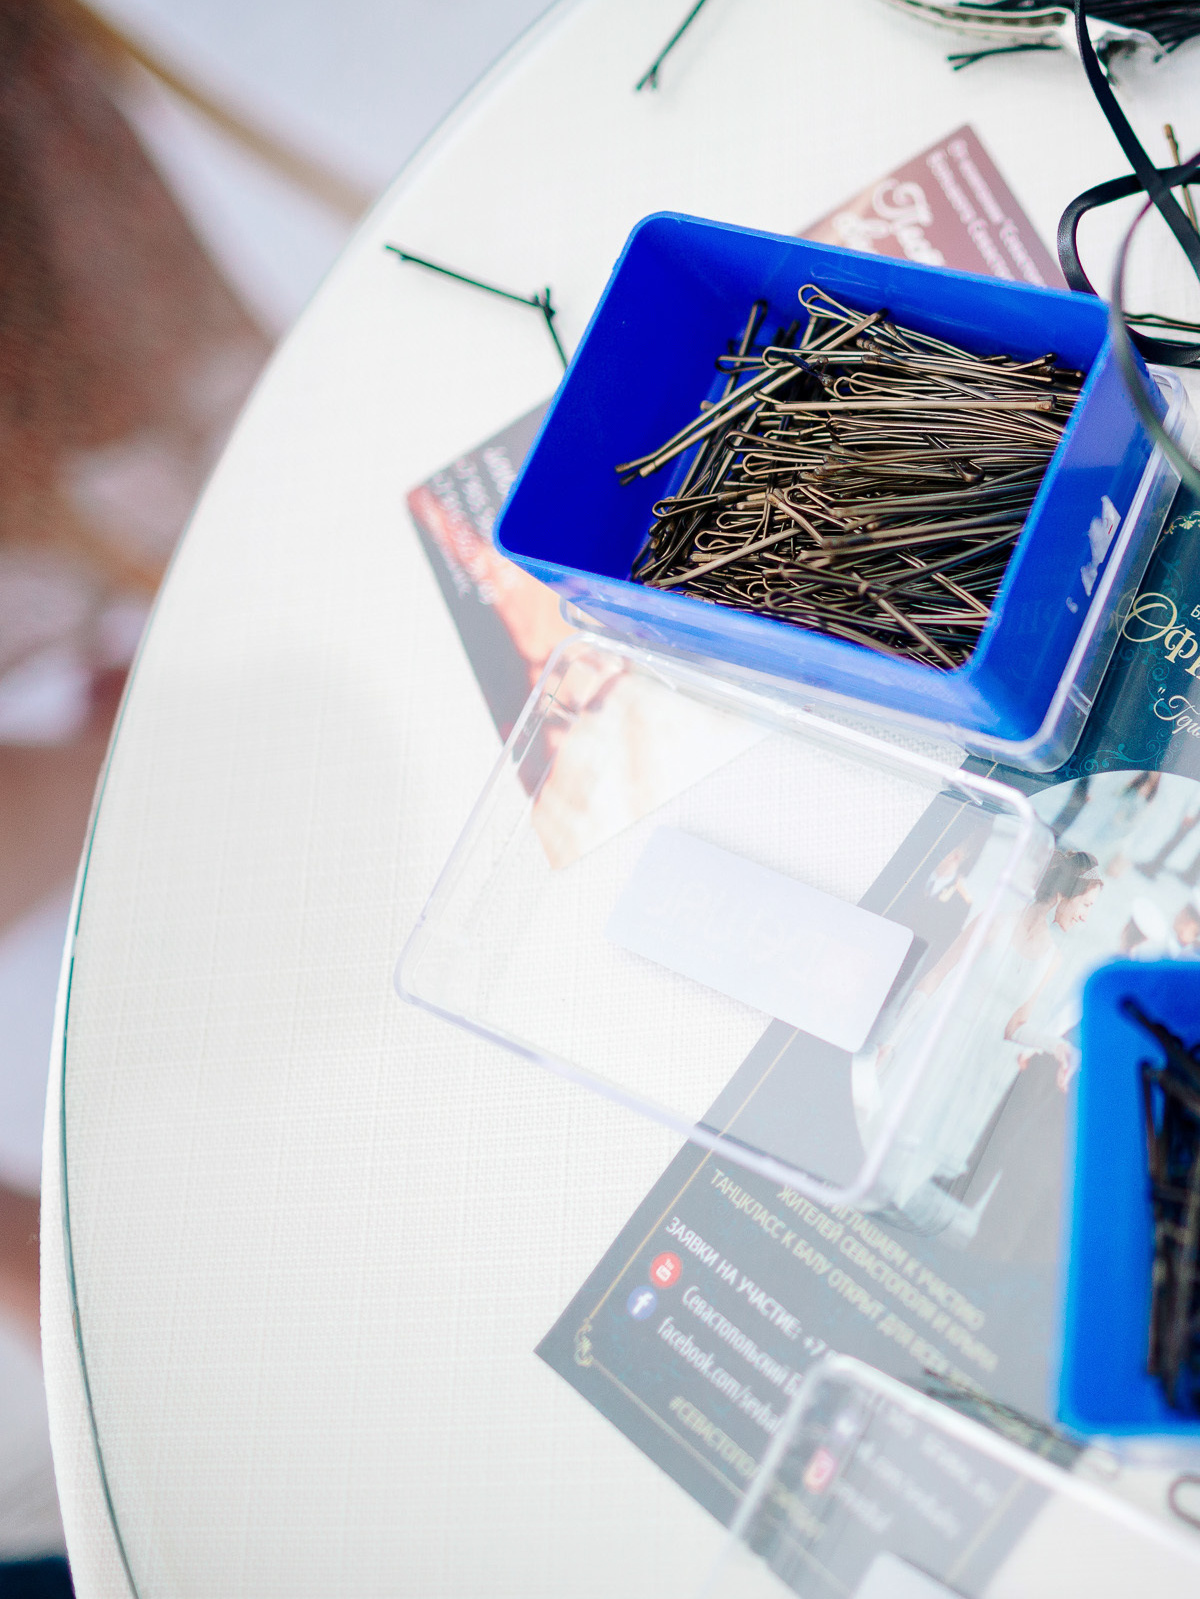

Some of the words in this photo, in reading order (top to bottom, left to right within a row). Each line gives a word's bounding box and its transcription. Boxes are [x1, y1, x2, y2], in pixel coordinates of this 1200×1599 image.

[665, 1216, 721, 1268] ЗАЯВКИ
[714, 1258, 739, 1286] НА
[735, 1275, 803, 1341] УЧАСТИЕ:
[803, 1334, 828, 1357] +7
[710, 1168, 786, 1239] ТАНЦКЛАСС
[780, 1229, 798, 1249] К
[792, 1238, 834, 1276] БАЛУ
[827, 1268, 888, 1321] ОТКРЫТ
[776, 1185, 846, 1244] ЖИТЕЛЕЙ
[839, 1235, 939, 1323] СЕВАСТОПОЛЯ
[824, 1185, 911, 1267] ИГЛАШАЕМ
[902, 1256, 922, 1279] К
[682, 1285, 791, 1387] Севастопольский
